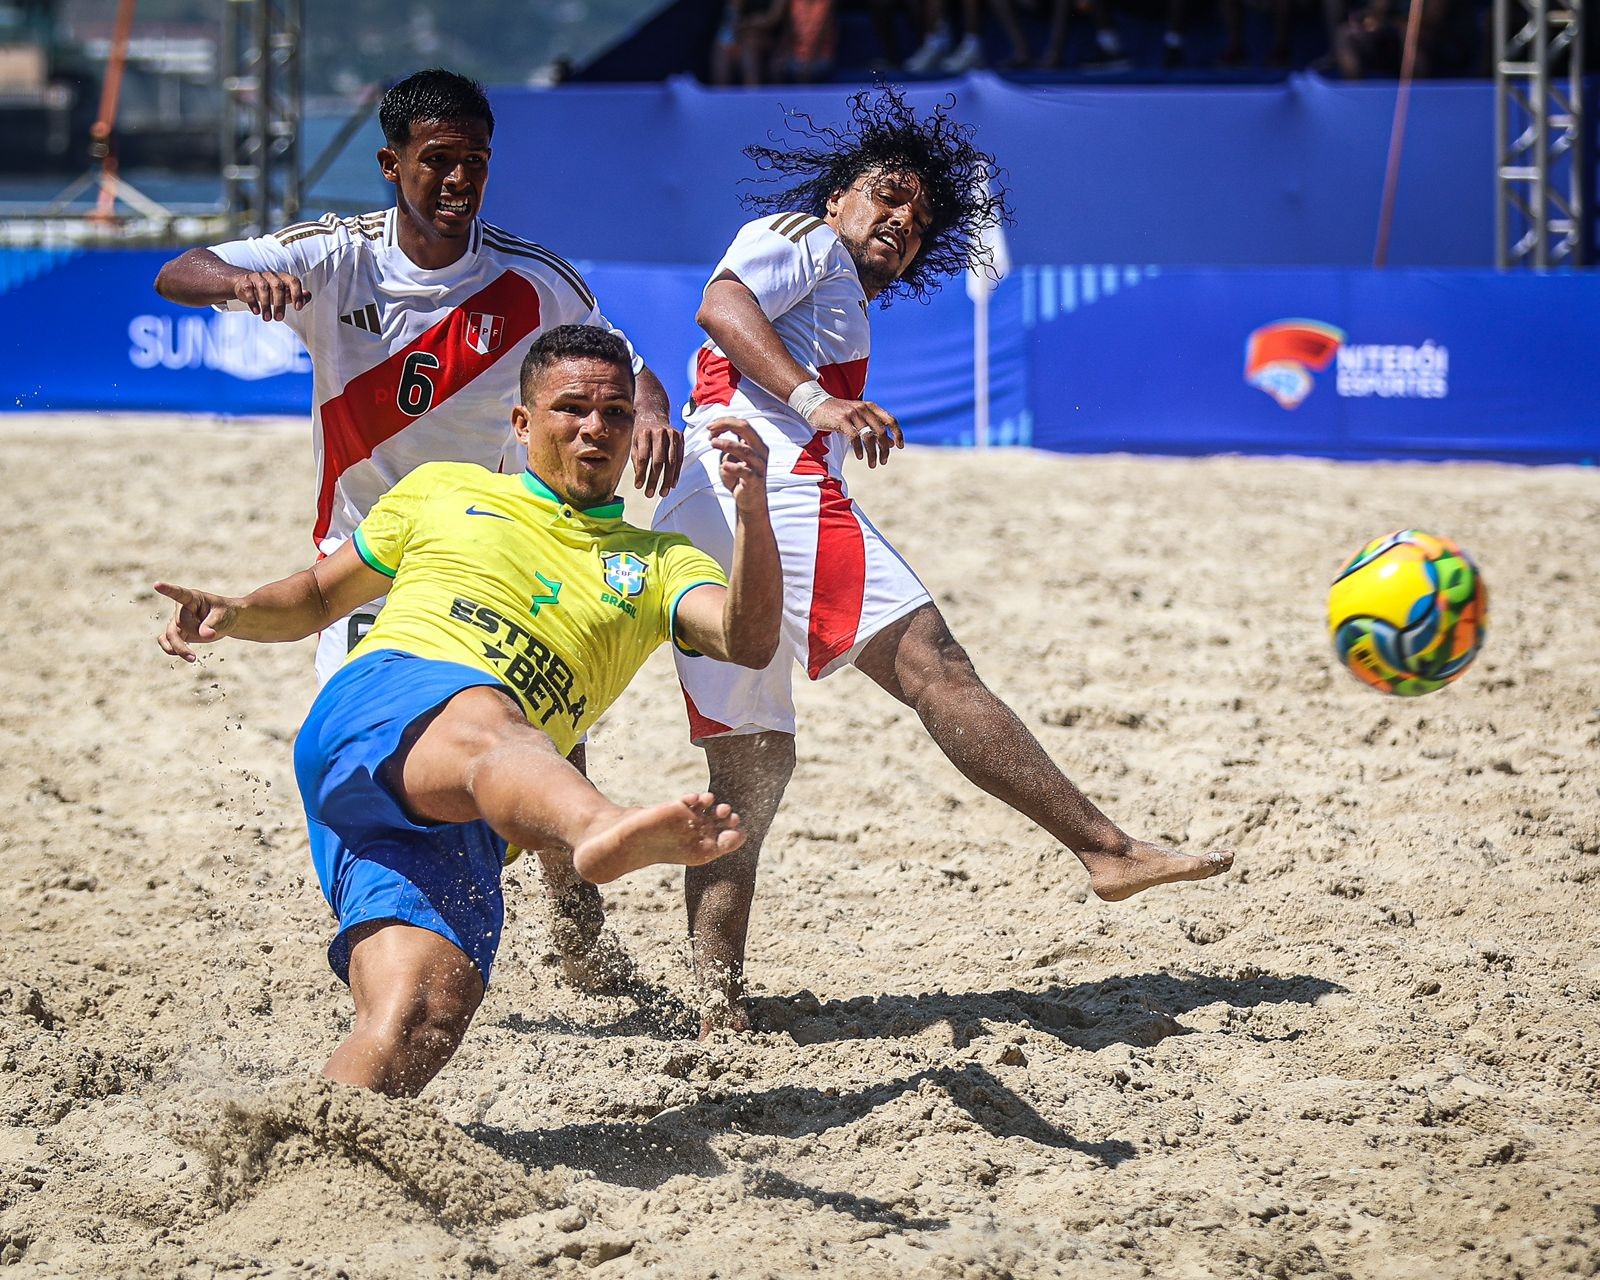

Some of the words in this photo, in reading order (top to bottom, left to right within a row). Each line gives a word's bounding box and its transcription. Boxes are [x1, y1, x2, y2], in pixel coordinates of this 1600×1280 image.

[396, 350, 440, 417] 6
[1337, 373, 1448, 398] ESPORTES
[615, 569, 633, 577] CBF
[600, 592, 637, 619] BRASIL
[449, 597, 587, 730] ESTRELA
[503, 652, 564, 726] BET
